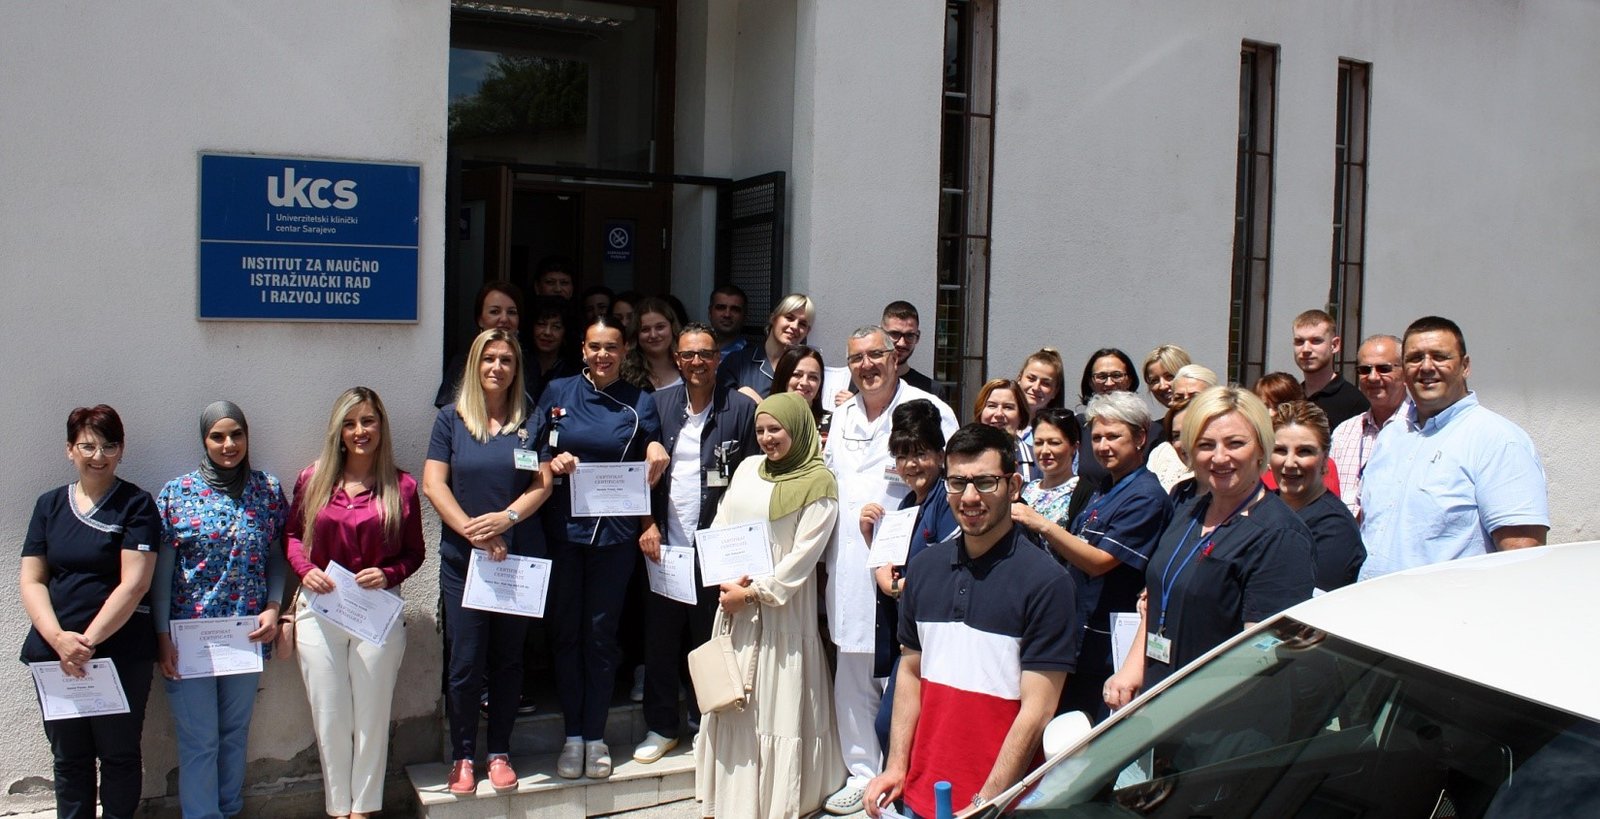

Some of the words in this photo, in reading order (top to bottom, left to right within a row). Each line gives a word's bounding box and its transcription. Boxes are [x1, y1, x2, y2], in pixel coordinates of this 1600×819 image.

[267, 167, 358, 210] ukcs
[275, 213, 329, 223] Univerzitetski
[330, 215, 358, 225] klinički
[275, 225, 301, 233] centar
[302, 225, 336, 235] Sarajevo
[242, 256, 302, 271] INSTITUT
[305, 259, 322, 272] ZA
[326, 257, 379, 273] NAUČNO
[250, 272, 341, 288] ISTRAŽIVAČKI
[345, 276, 371, 289] RAD
[261, 290, 266, 303] I
[270, 291, 321, 304] RAZVOJ
[326, 292, 361, 305] UKCS
